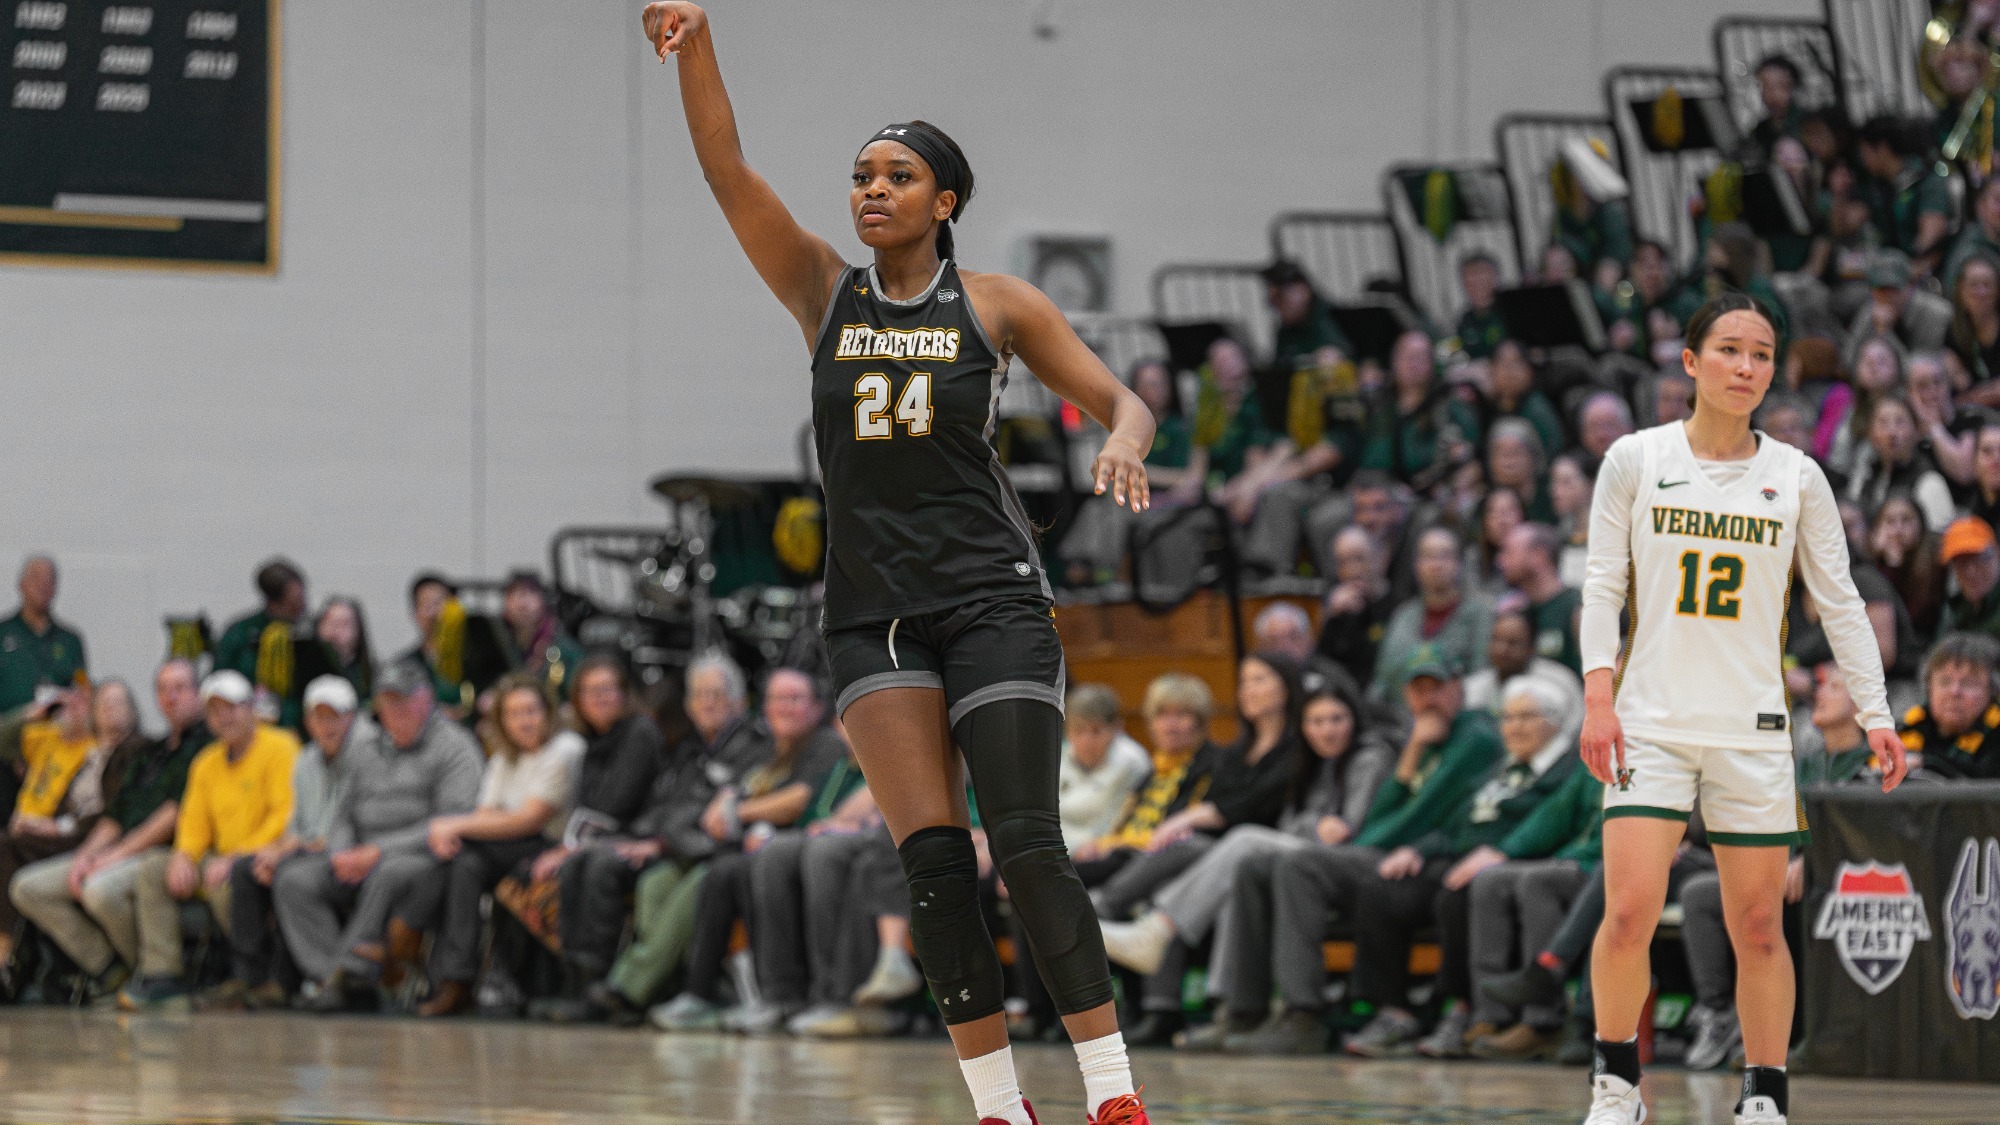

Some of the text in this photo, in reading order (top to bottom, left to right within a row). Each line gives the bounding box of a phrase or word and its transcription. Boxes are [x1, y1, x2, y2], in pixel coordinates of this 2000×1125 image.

[835, 324, 960, 362] RETRIEVERS
[854, 373, 934, 440] 24
[1652, 507, 1784, 547] VERMONT
[1676, 549, 1746, 621] 12
[1822, 900, 1928, 932] AMERICA
[1846, 930, 1904, 951] EAST
